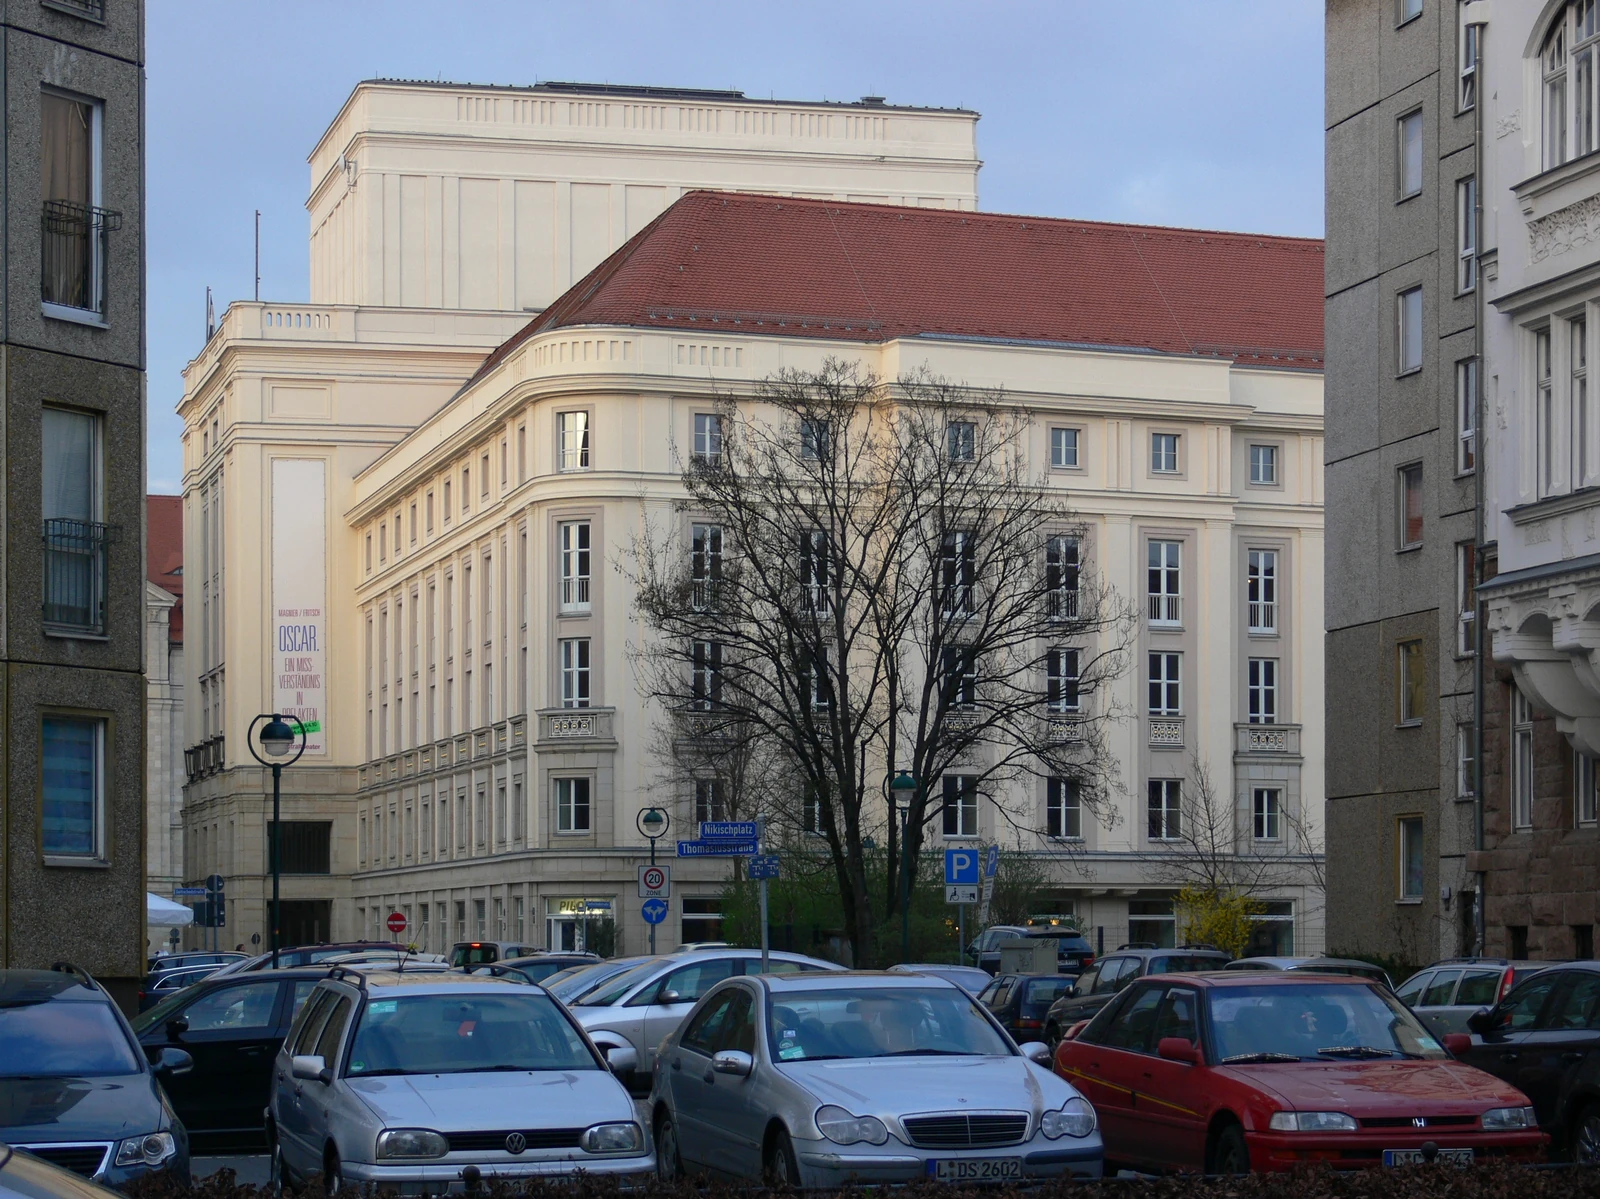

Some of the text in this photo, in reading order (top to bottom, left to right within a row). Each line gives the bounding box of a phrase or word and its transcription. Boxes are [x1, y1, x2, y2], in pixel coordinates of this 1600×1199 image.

[278, 624, 320, 652] OSCAR.
[284, 657, 315, 672] EIN MISS-
[278, 672, 321, 689] VERSTÄNDNIS
[296, 691, 304, 706] IN
[297, 707, 318, 722] AKTEN
[704, 822, 753, 836] Nikischplatz
[681, 843, 754, 854] Thomasiusstraße
[953, 853, 971, 880] P
[987, 850, 996, 874] P
[648, 873, 661, 884] 20
[559, 901, 587, 912] PILO
[937, 1161, 1019, 1178] L DS 2602
